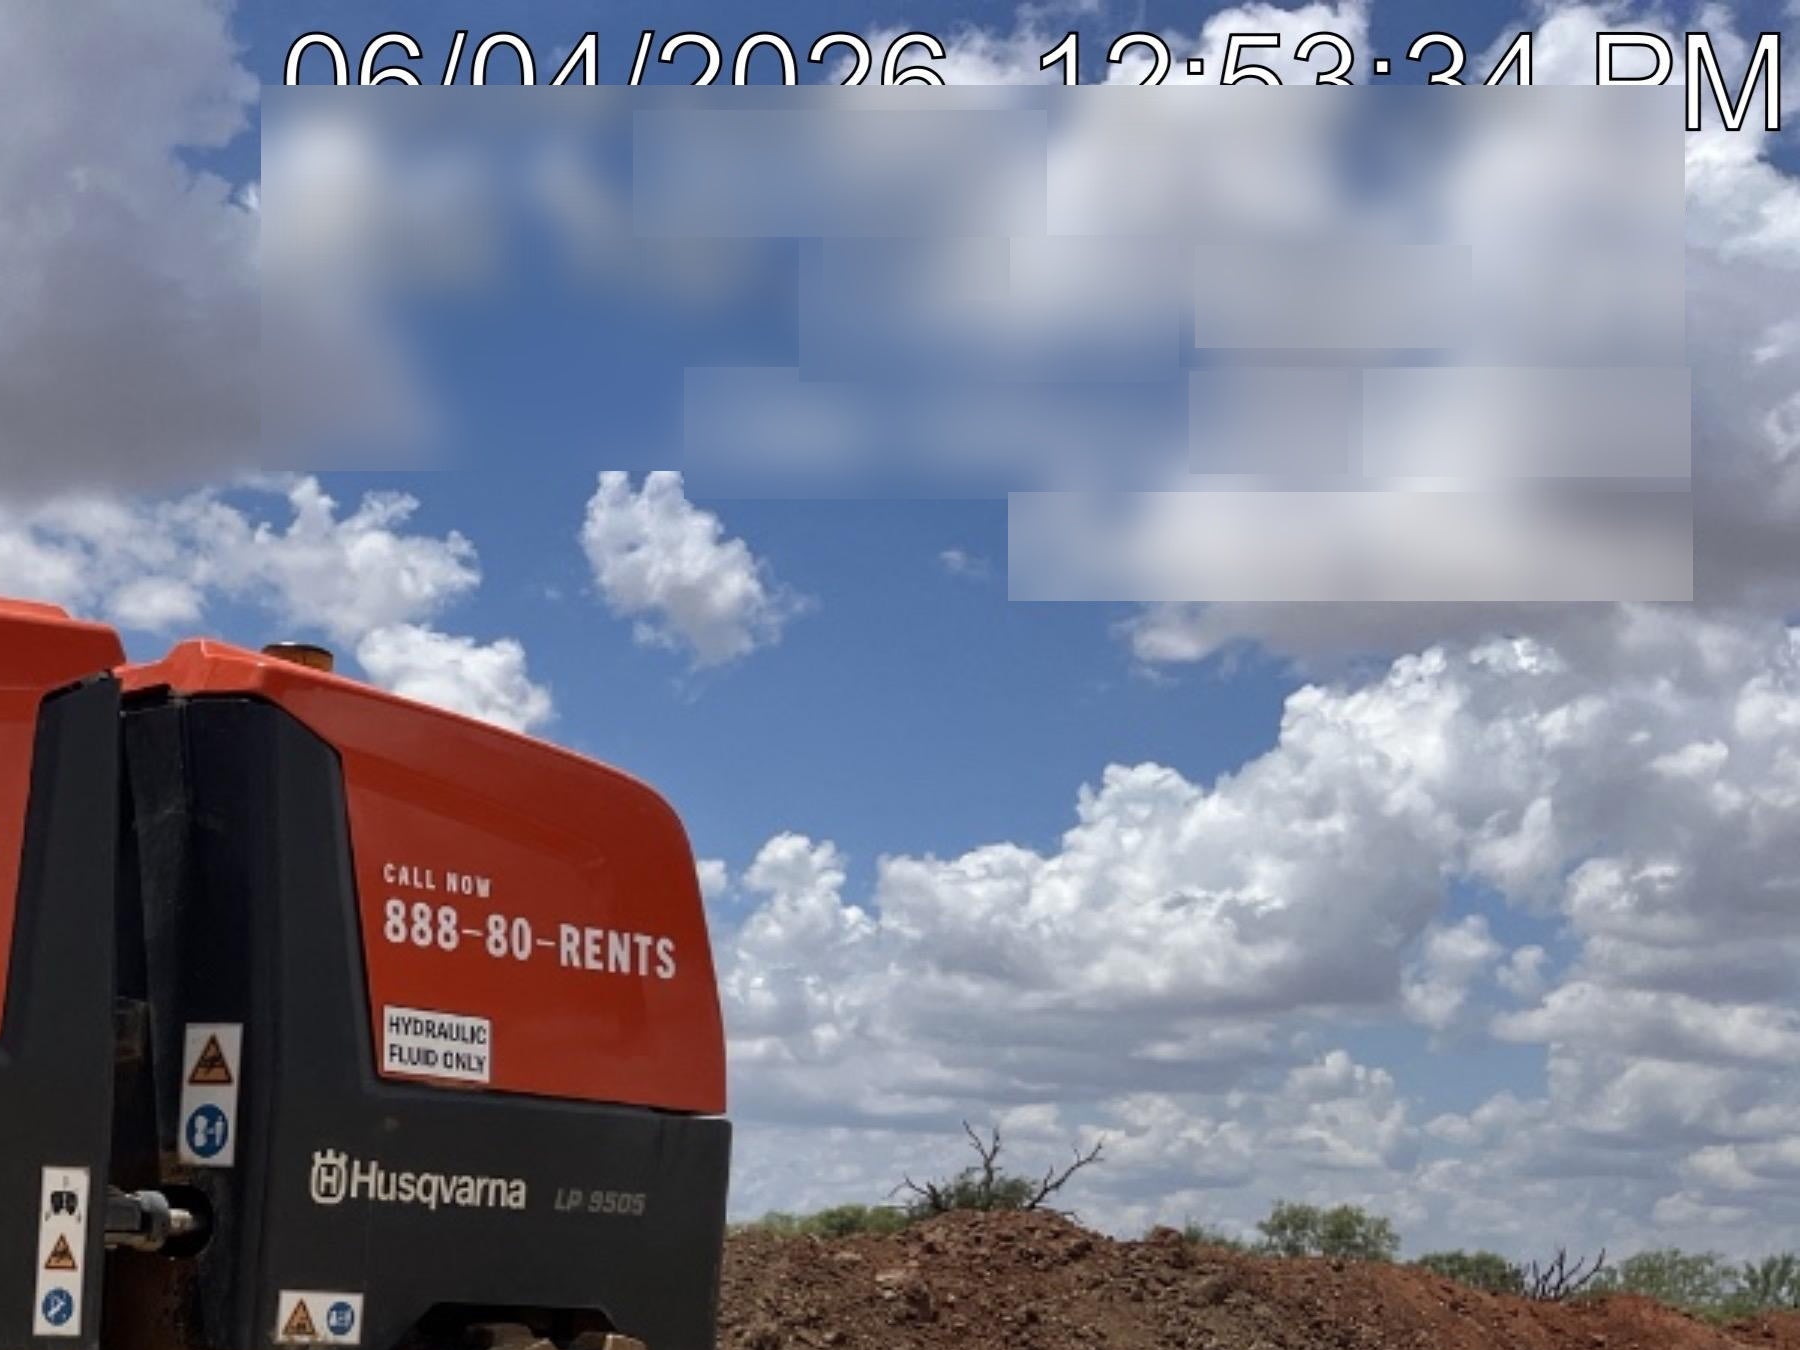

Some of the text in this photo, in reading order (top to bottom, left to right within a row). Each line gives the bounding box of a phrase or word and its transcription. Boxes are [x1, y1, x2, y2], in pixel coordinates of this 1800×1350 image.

[383, 863, 492, 898] CALL NOW
[383, 898, 677, 980] 888-80-RENTS
[388, 1015, 488, 1046] HYDRAULIC
[388, 1044, 487, 1074] FLUID ONLY
[350, 1158, 528, 1211] Husqvarna
[553, 1187, 584, 1212] LP
